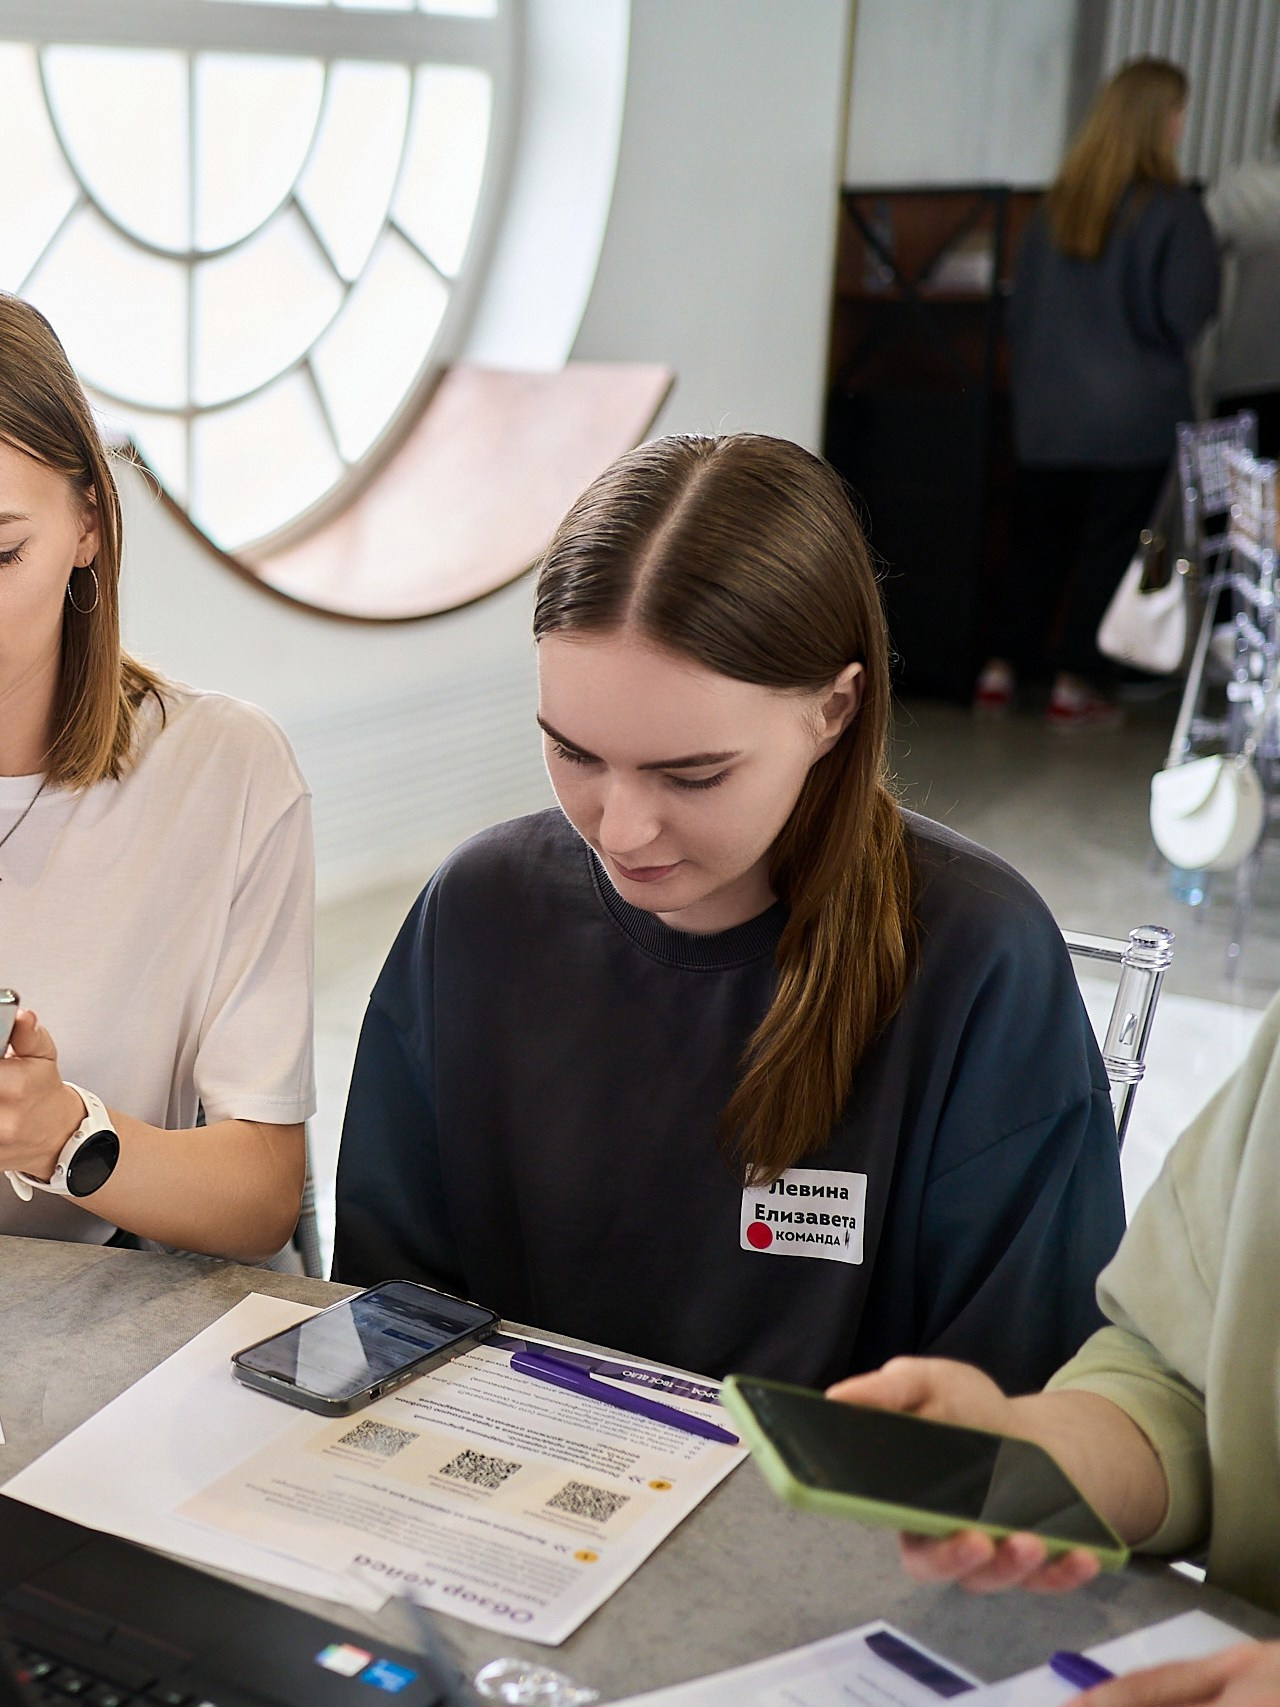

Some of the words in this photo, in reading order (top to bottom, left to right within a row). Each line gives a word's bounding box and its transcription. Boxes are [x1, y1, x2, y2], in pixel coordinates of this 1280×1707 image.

[768, 1178, 849, 1200] Левина
[754, 1203, 856, 1230] Елизавета
[775, 1230, 841, 1247] КОМАНДА
[622, 1370, 650, 1383] ДЕЛО
[354, 1555, 435, 1586] кейса
[444, 1586, 532, 1622] Обзор
